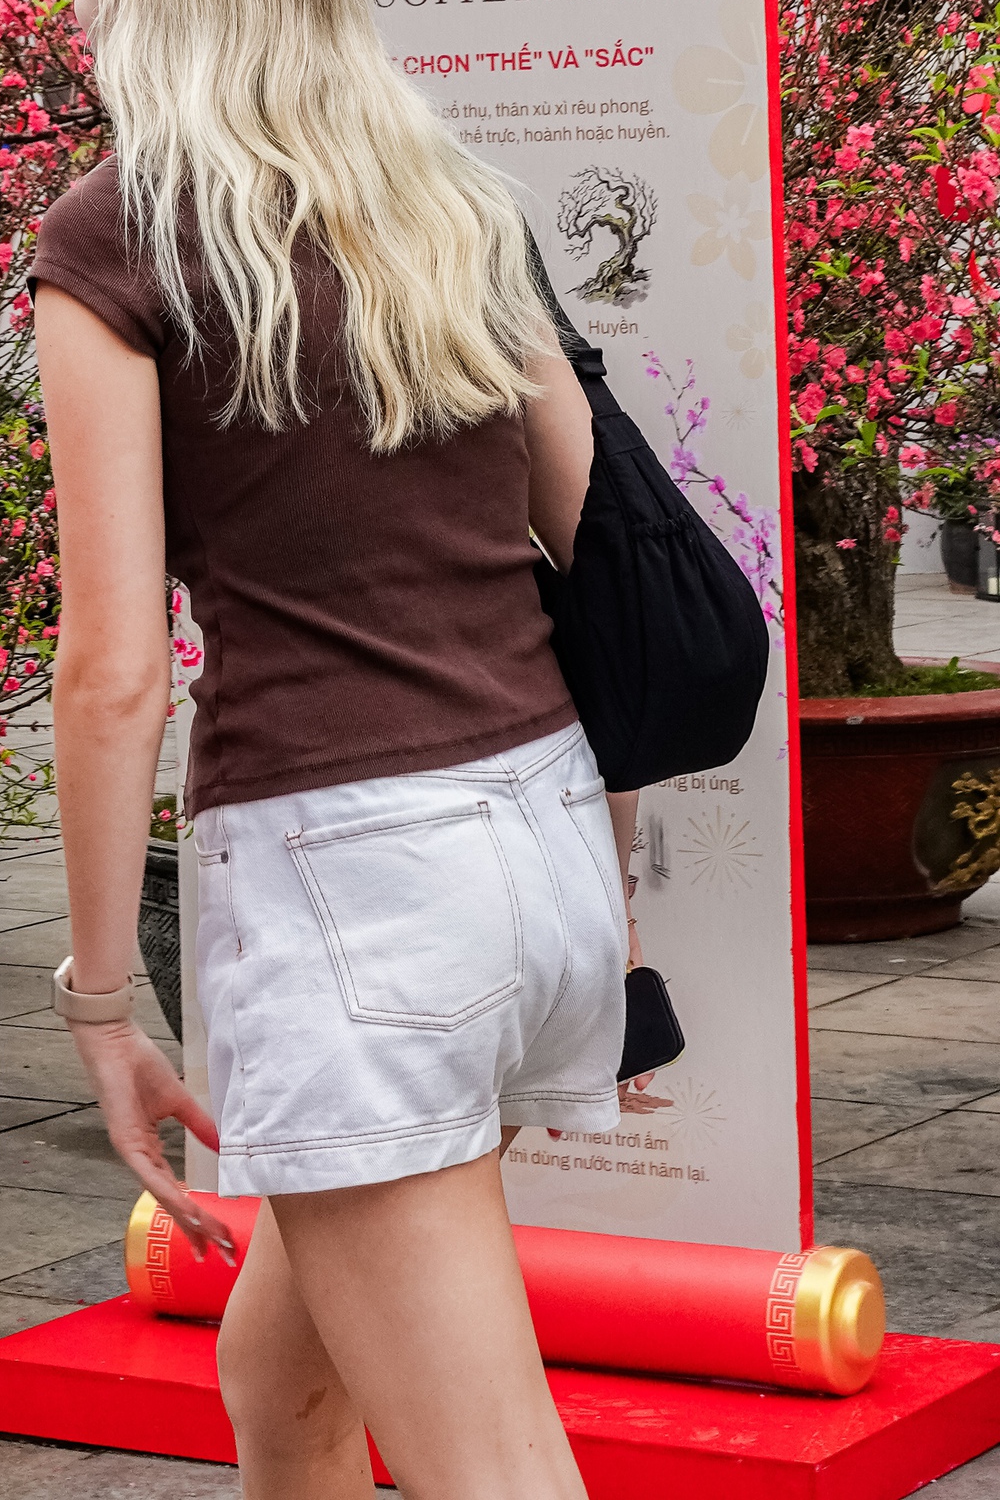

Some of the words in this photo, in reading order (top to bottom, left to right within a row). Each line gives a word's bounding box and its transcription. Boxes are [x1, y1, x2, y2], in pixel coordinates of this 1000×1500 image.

[403, 53, 470, 79] CHỌN
[475, 42, 542, 72] "THẾ"
[547, 45, 579, 69] VÀ
[584, 38, 654, 68] "SẮC"
[495, 101, 529, 117] thân
[571, 99, 596, 115] rêu
[600, 98, 654, 117] phong.
[524, 127, 572, 142] hoành
[576, 125, 614, 144] hoặc
[617, 120, 670, 142] huyền.
[588, 315, 638, 337] Huyền
[530, 1150, 571, 1171] dùng
[573, 1154, 613, 1172] nước
[616, 1160, 646, 1176] mát
